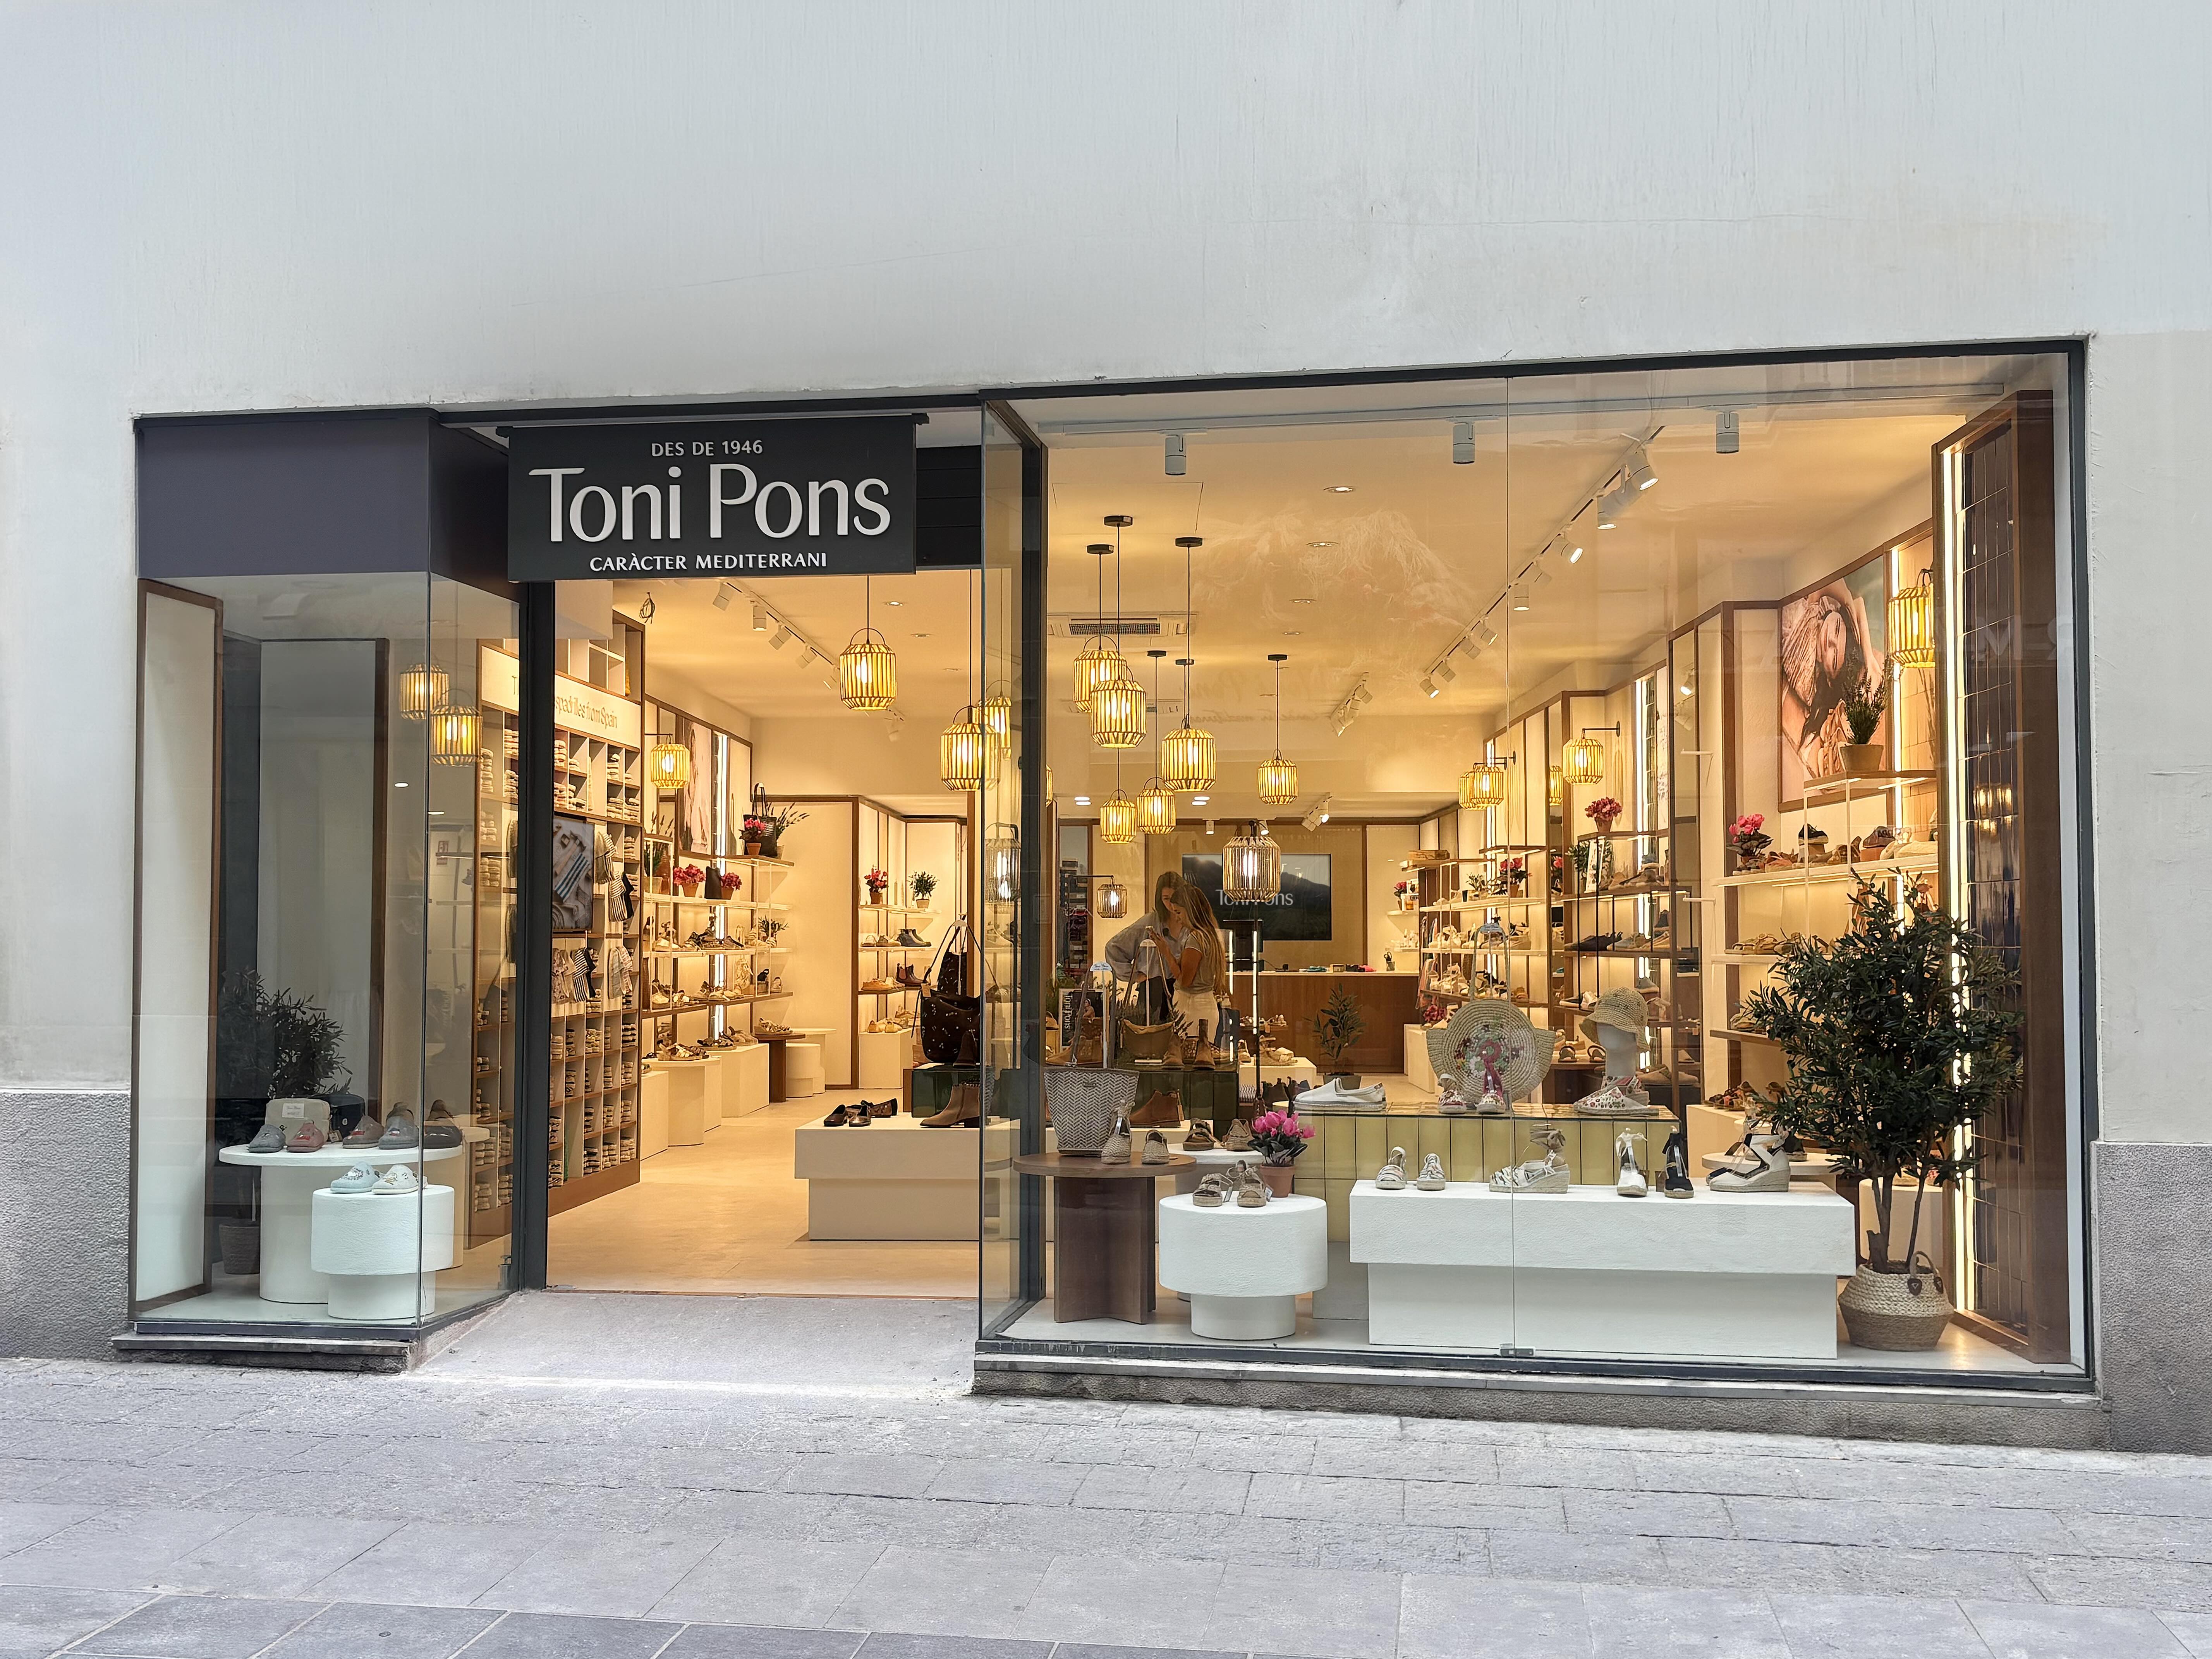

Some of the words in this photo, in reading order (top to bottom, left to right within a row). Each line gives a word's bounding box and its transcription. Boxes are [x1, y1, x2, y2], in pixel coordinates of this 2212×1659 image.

[651, 443, 684, 457] DES
[692, 441, 714, 456] DE
[722, 440, 763, 454] 1946
[528, 466, 682, 543] Toni
[709, 463, 891, 539] Pons
[589, 552, 687, 572] CARÀCTER
[695, 552, 827, 569] MEDITERRANI
[601, 707, 617, 729] Spain
